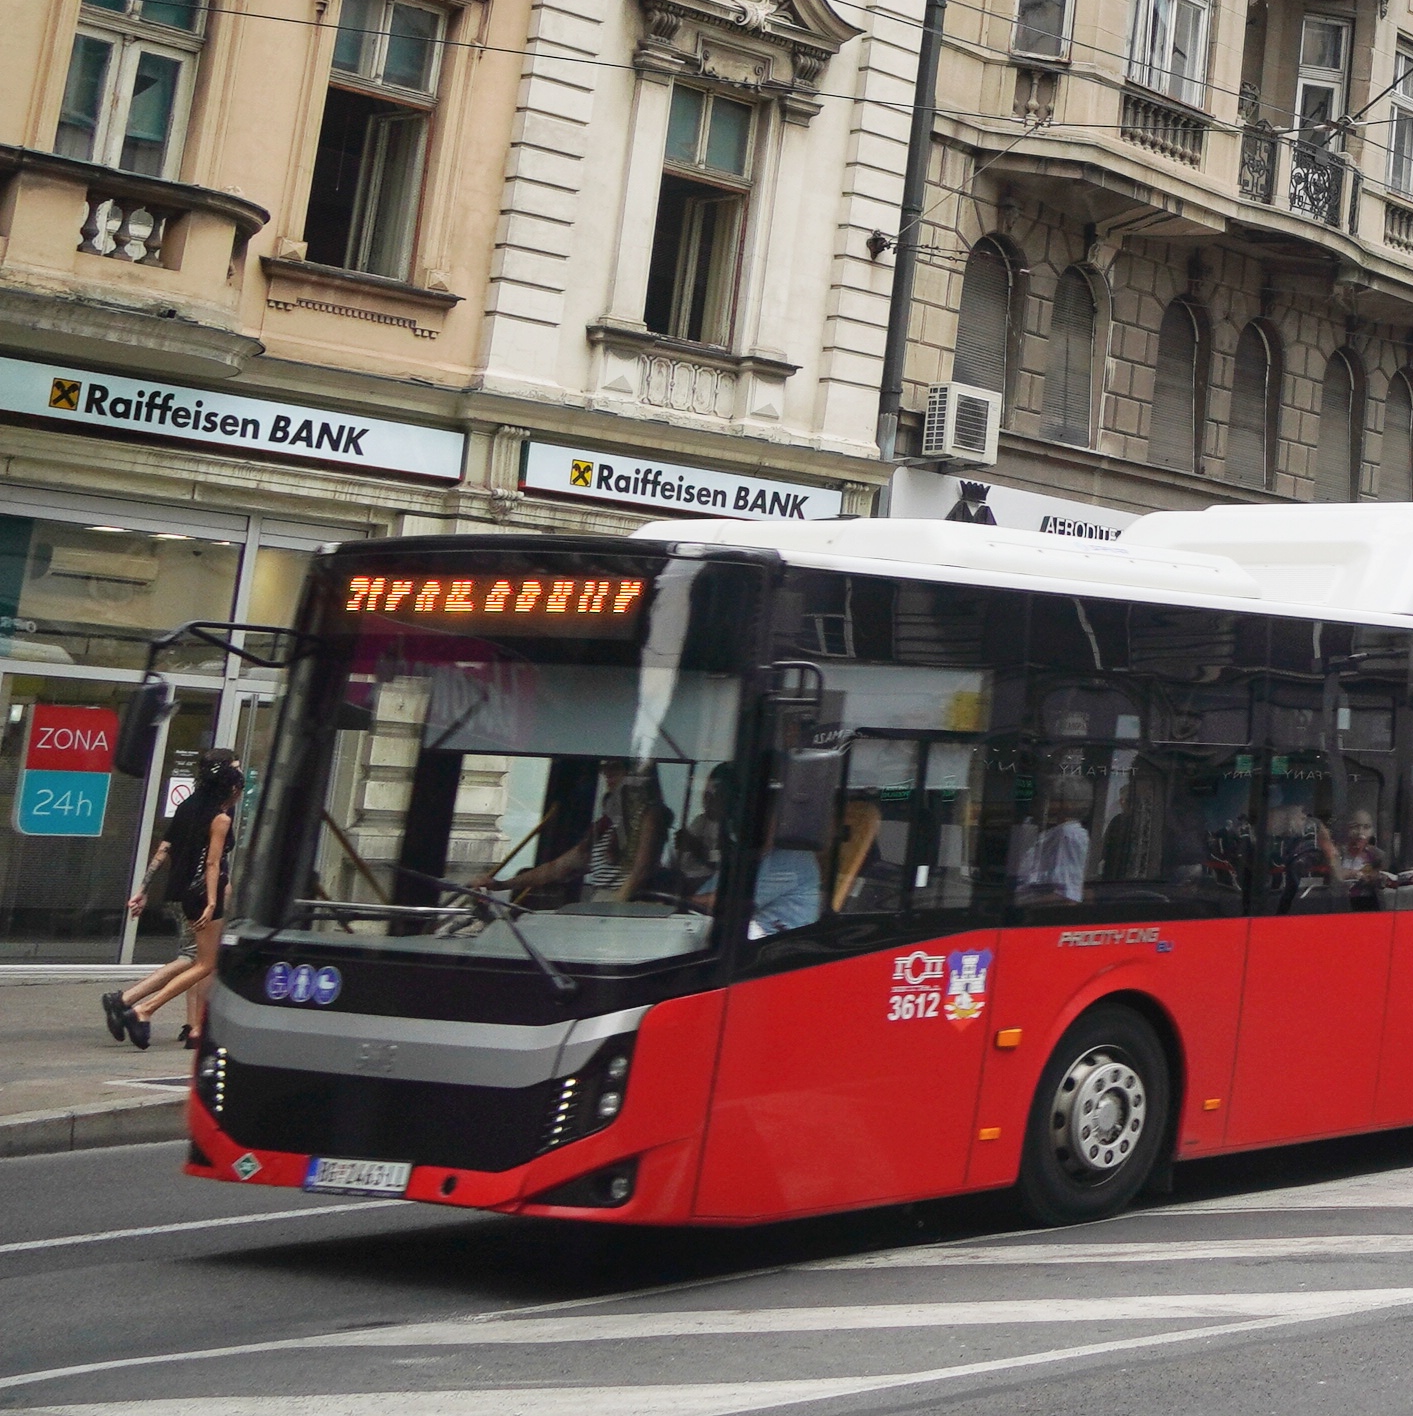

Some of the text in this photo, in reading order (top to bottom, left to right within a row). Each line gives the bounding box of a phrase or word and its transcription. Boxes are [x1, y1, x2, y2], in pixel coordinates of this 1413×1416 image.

[85, 383, 370, 456] Raiffeisen BANK
[596, 463, 810, 520] Raiffeisen BANK
[37, 727, 109, 752] ZONA
[32, 789, 93, 817] 24h
[887, 991, 941, 1021] 3612
